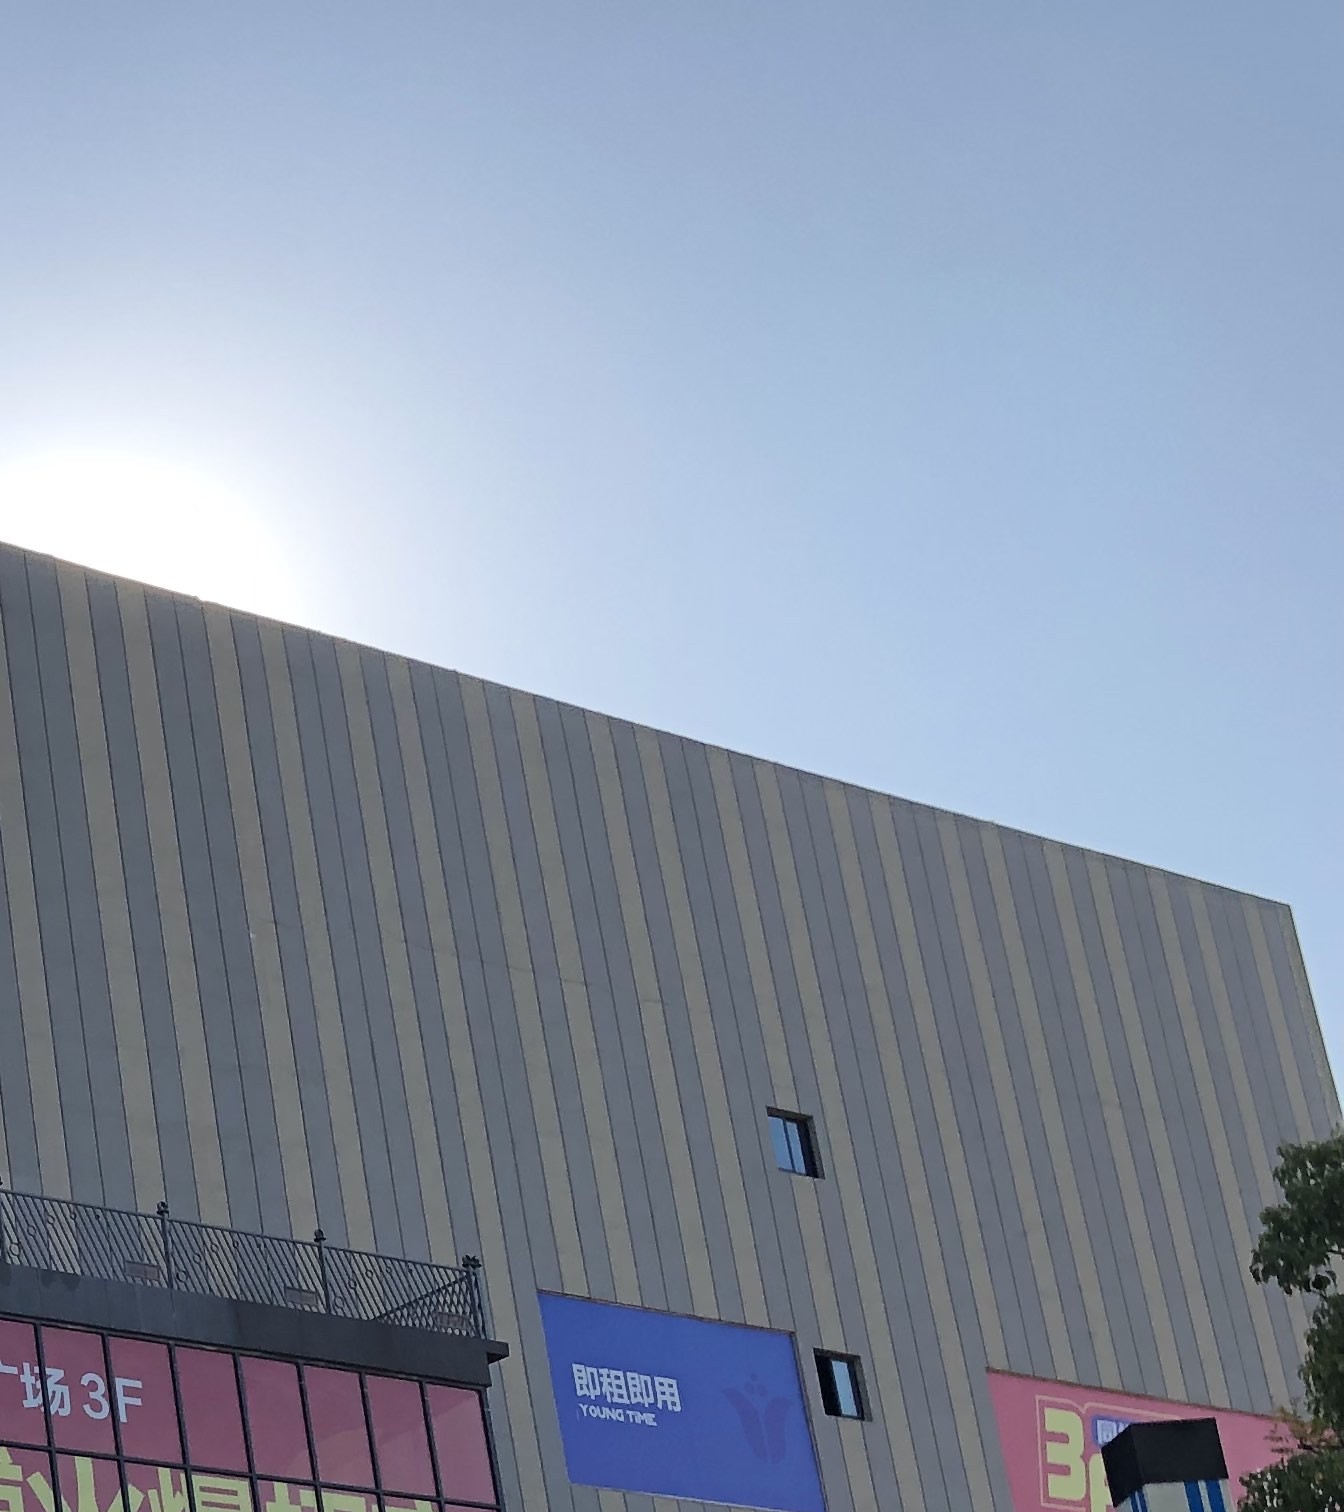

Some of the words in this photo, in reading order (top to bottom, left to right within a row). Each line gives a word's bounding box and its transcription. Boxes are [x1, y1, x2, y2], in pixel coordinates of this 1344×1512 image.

[80, 1372, 144, 1424] 3F
[572, 1363, 682, 1412] 即租即用
[578, 1403, 624, 1422] YOUNG
[626, 1409, 658, 1427] TIME
